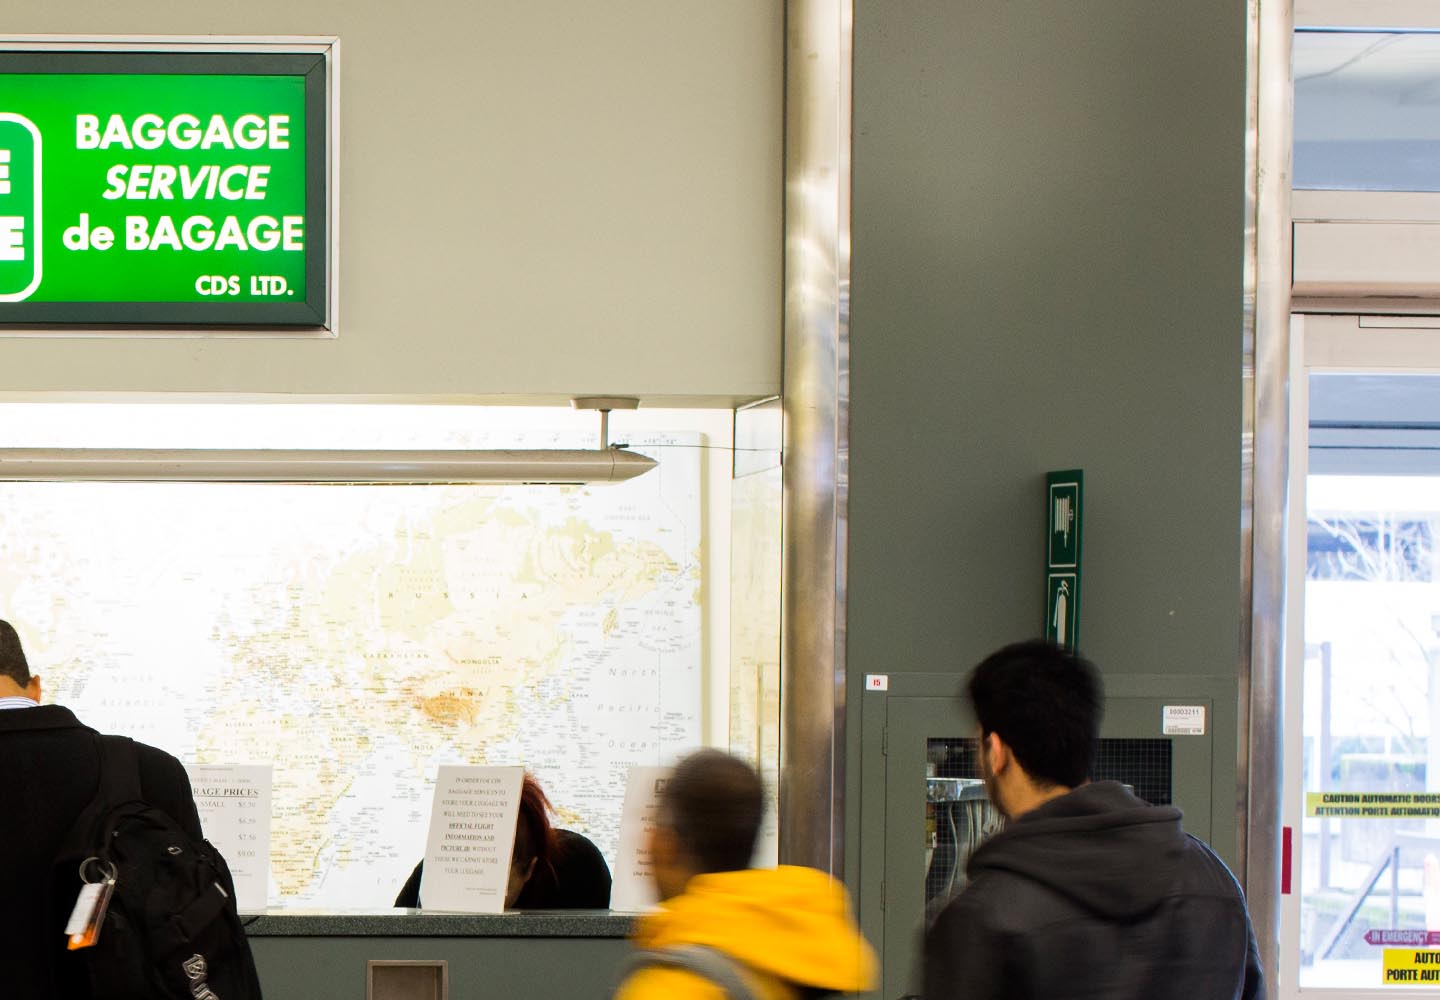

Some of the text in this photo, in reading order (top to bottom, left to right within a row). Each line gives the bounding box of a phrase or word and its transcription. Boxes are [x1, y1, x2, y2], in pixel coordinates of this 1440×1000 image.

[75, 113, 290, 151] BAGGAGE
[102, 165, 270, 201] SERVICE
[62, 213, 304, 252] de BAGAGE
[195, 276, 294, 296] CDS LTD.
[608, 667, 657, 677] North
[597, 703, 661, 713] Pacific
[608, 739, 658, 749] Ocean
[223, 788, 259, 796] PRICES
[1322, 794, 1360, 803] CAUTION
[1361, 794, 1412, 803] AUTOMATIC
[1315, 807, 1360, 816] ATTENTION
[1361, 807, 1389, 816] PORTE
[1371, 930, 1381, 944] IN
[1382, 930, 1428, 945] EMERGENCY
[1415, 952, 1440, 964] AUTO
[1387, 969, 1440, 981] PORTE AUT
